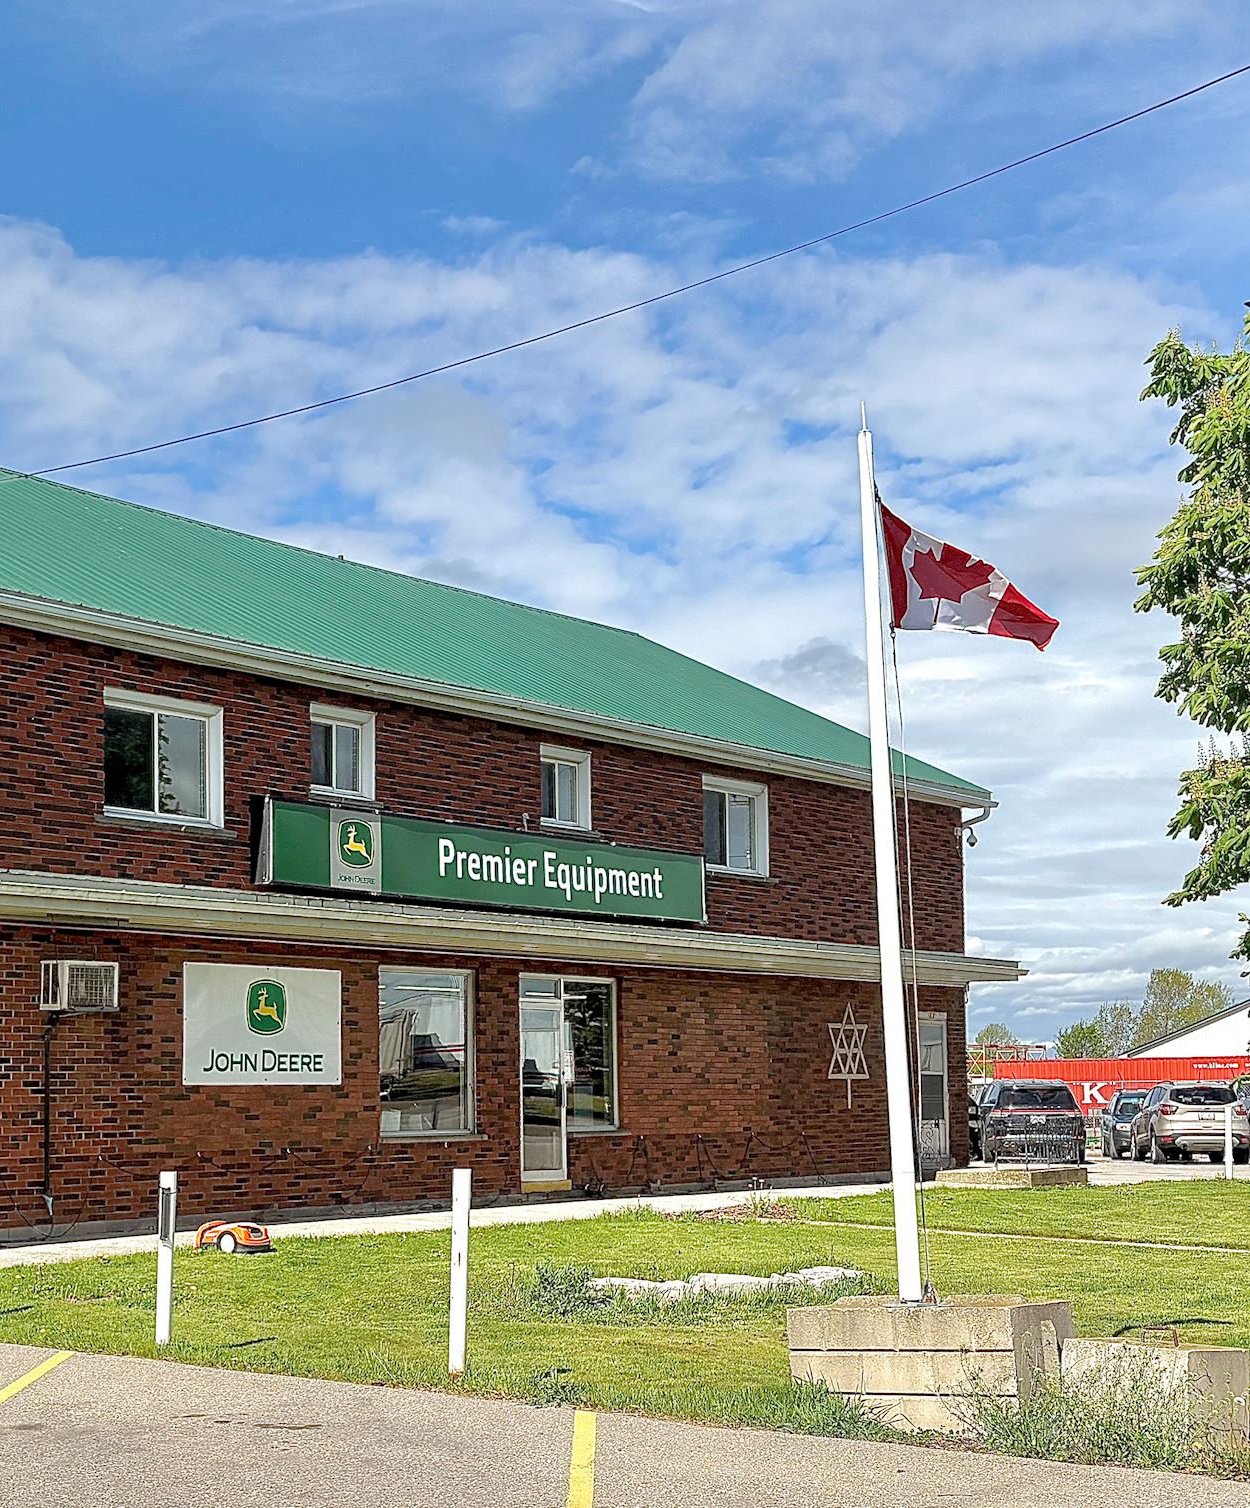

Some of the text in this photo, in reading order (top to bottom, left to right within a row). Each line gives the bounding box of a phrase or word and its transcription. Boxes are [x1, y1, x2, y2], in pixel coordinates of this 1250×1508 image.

[438, 838, 663, 904] Premier Equipment
[203, 1049, 323, 1072] JOHN DEERE
